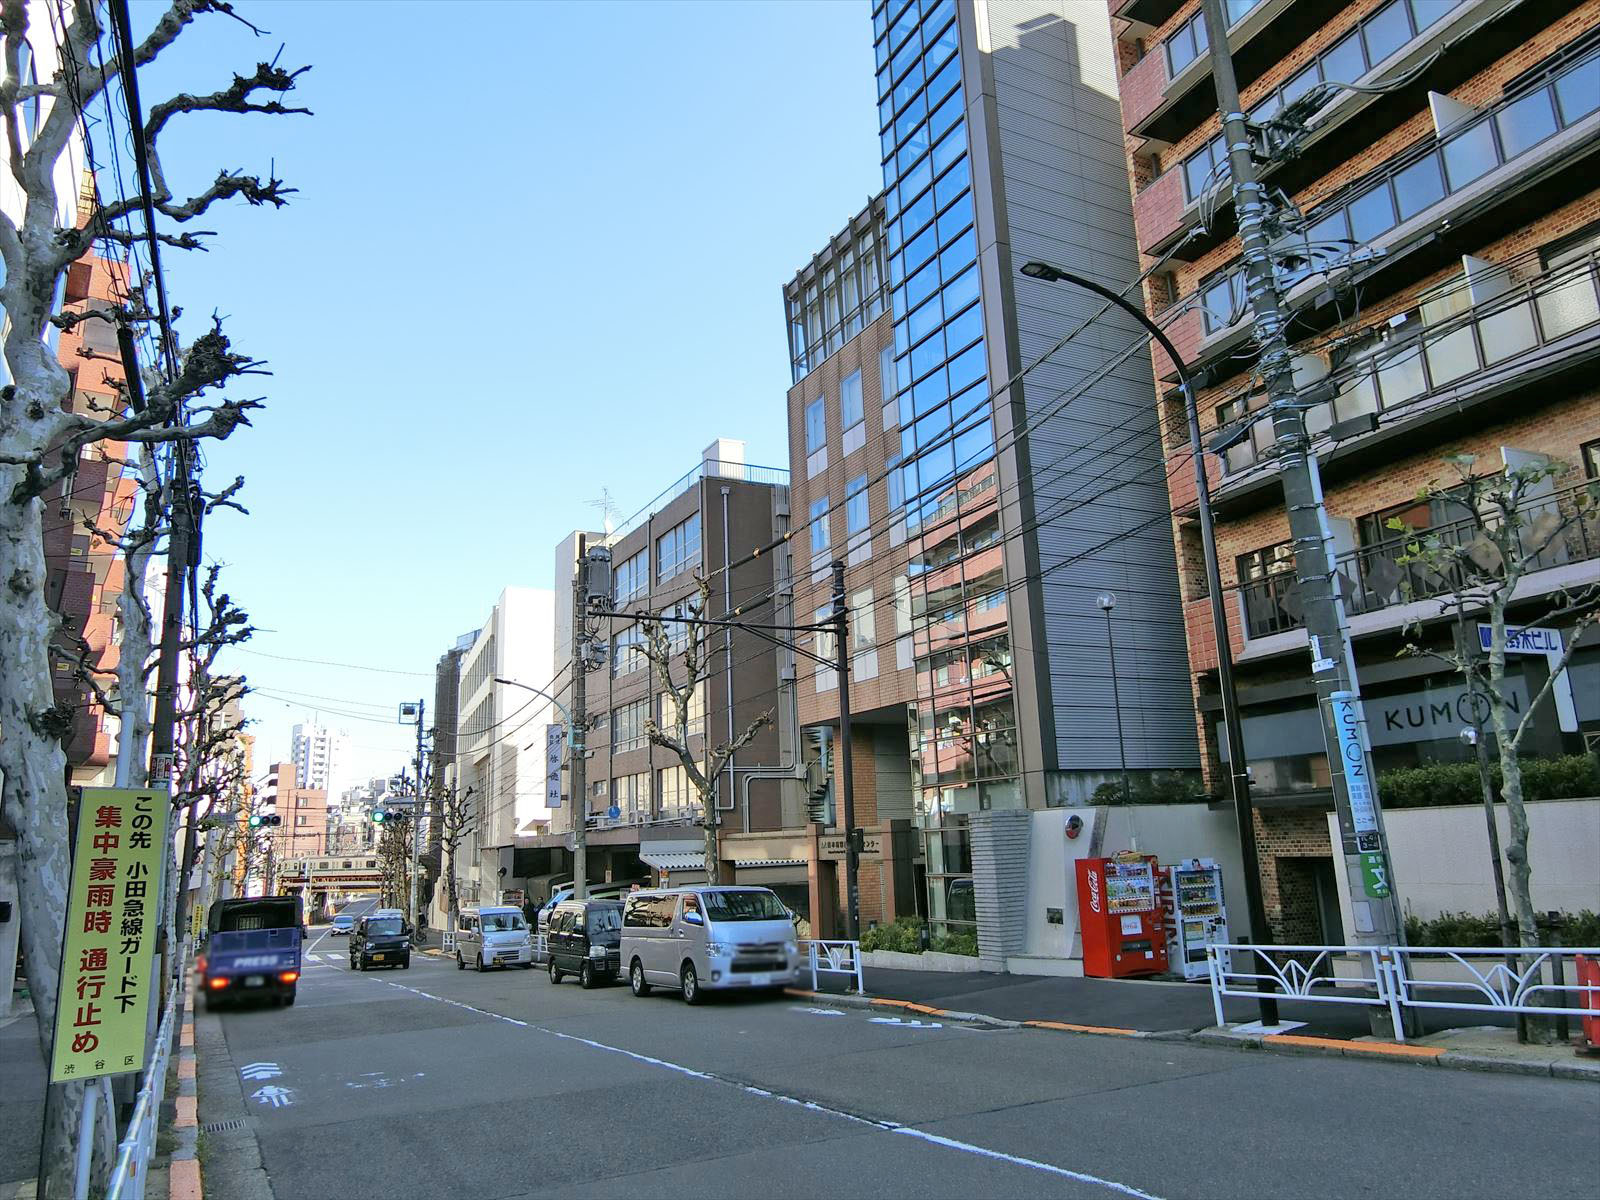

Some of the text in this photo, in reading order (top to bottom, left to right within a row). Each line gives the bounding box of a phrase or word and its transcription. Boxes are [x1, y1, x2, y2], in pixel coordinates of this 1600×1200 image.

[1340, 700, 1364, 777] KUMON
[1384, 691, 1520, 731] KUMON
[113, 796, 153, 1014] この先 小田急線ガード下
[1087, 868, 1101, 913] Coca-Cola
[1159, 869, 1178, 946] KIRIN
[71, 805, 122, 1054] 集中豪雨時 通行止め
[63, 1054, 135, 1075] 渋谷区
